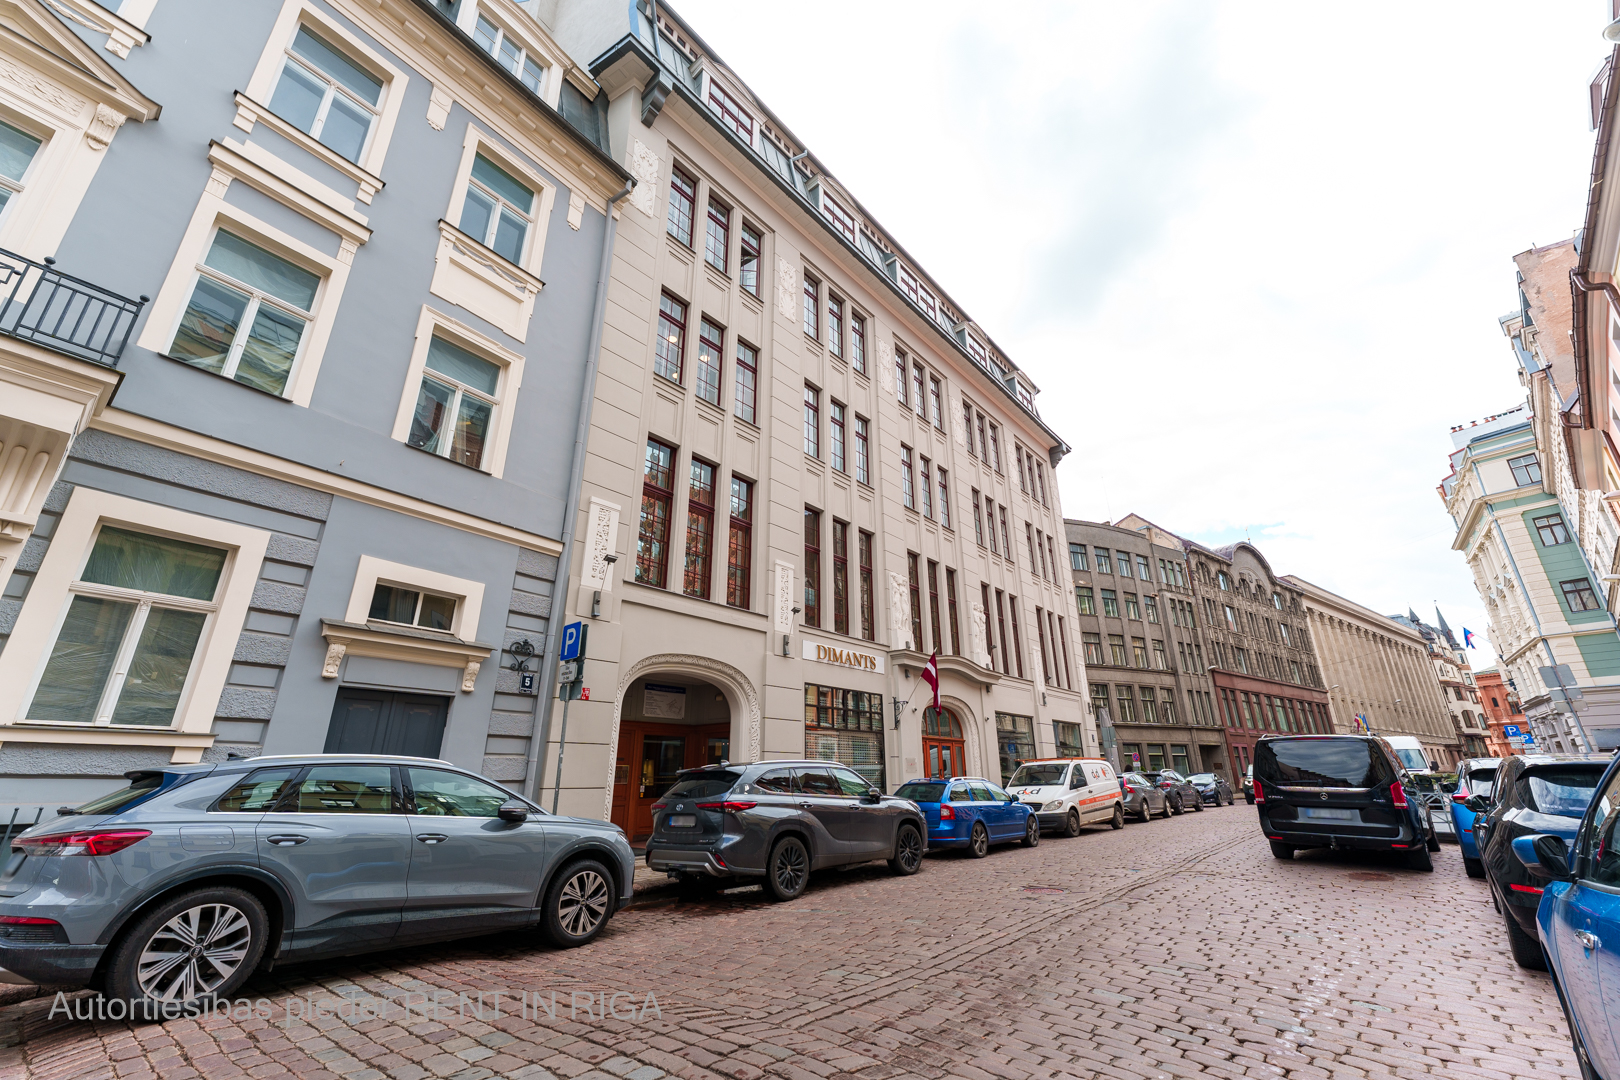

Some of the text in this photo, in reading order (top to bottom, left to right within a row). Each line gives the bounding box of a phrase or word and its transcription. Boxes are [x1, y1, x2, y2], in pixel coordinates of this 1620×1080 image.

[565, 628, 576, 655] P
[817, 644, 876, 670] DIMANTS
[525, 678, 531, 686] 5
[1508, 727, 1516, 735] P
